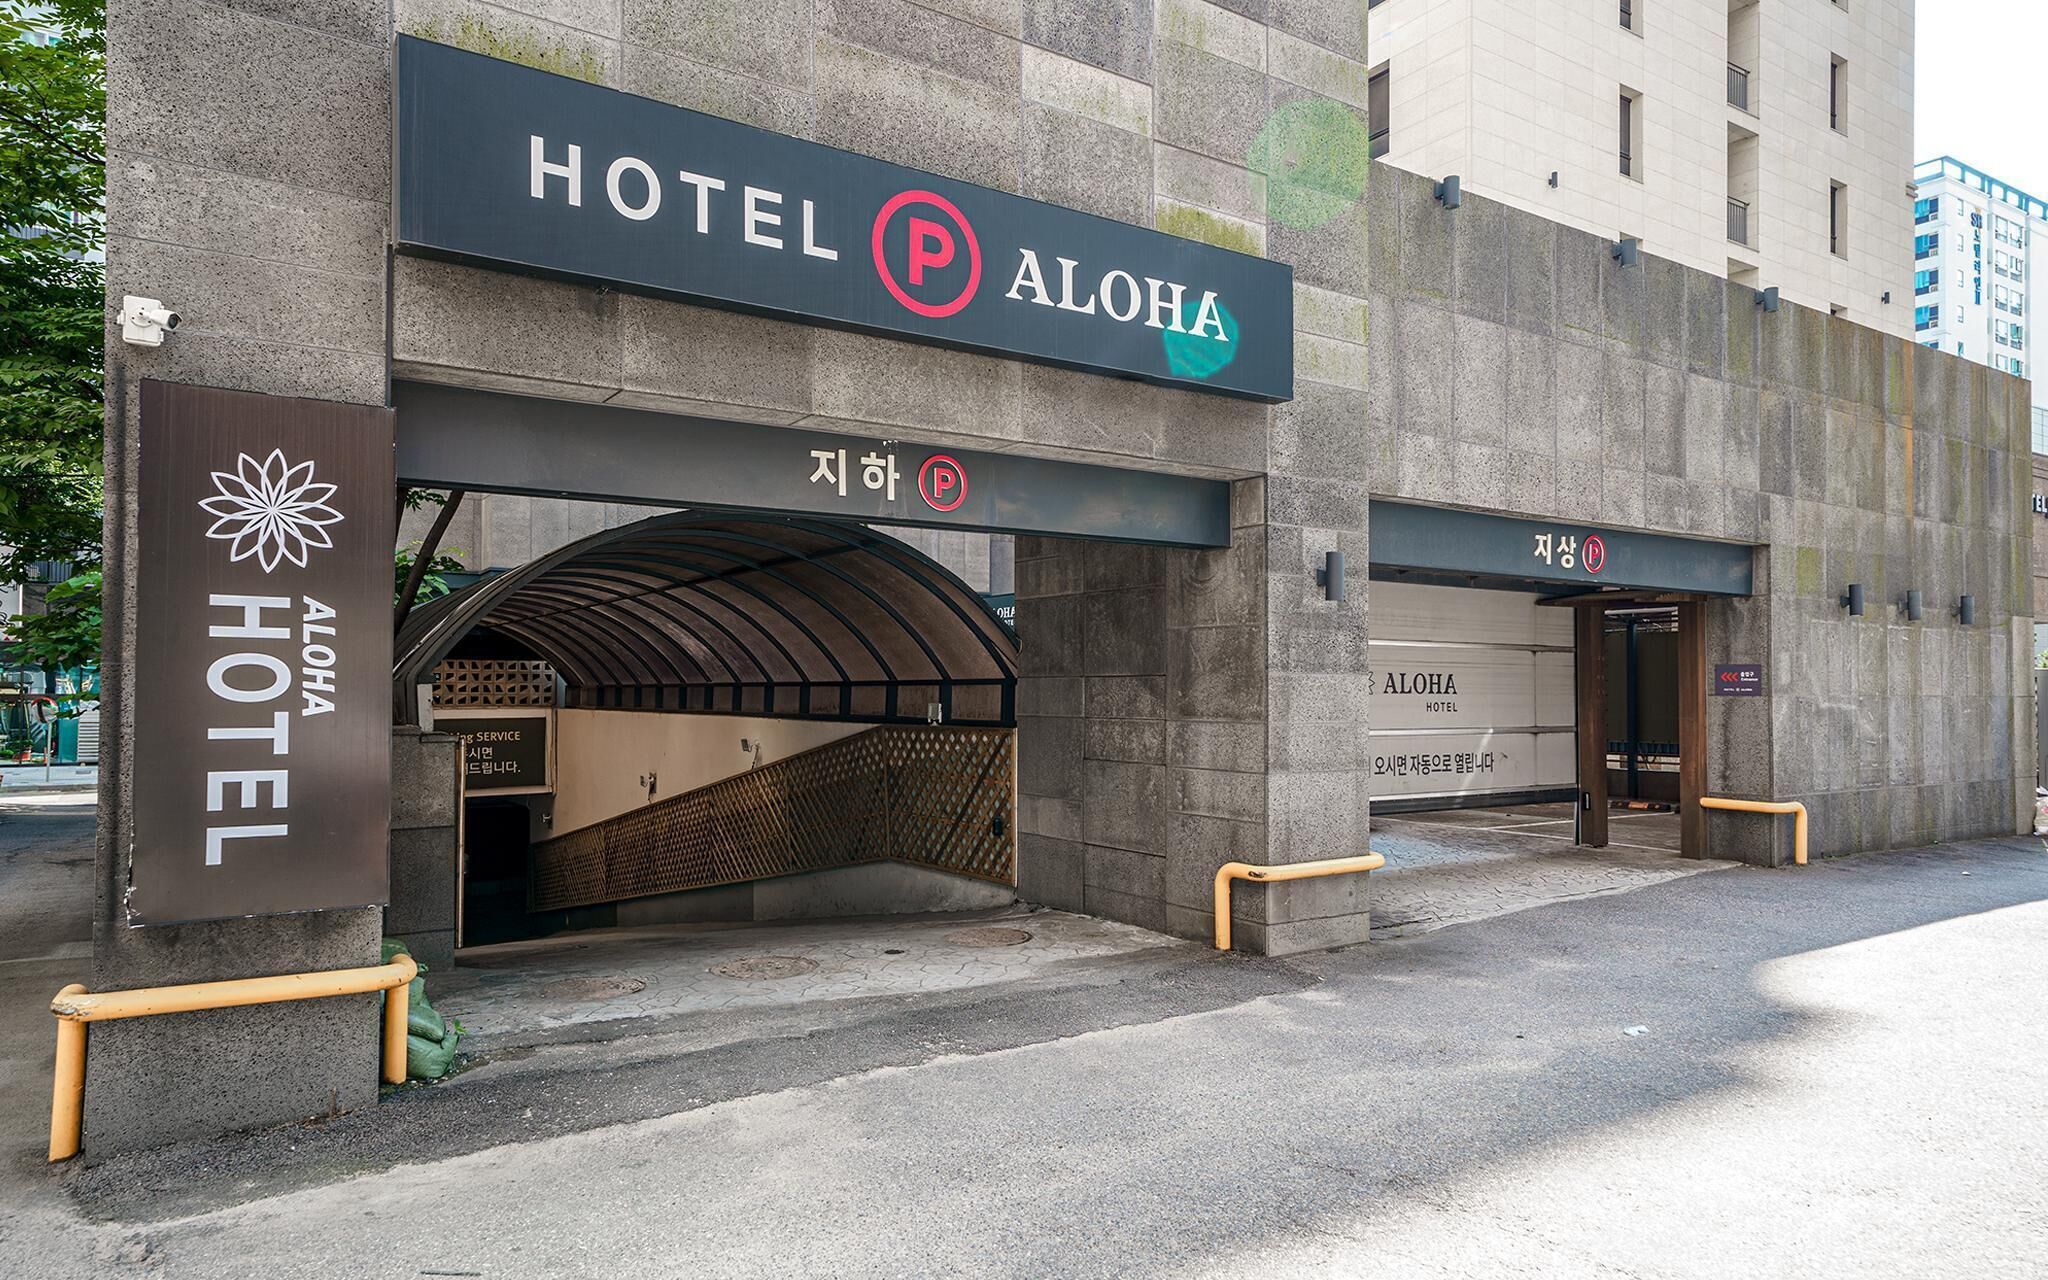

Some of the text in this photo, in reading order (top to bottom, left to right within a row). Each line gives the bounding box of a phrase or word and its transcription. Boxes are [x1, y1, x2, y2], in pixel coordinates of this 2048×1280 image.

[530, 134, 838, 262] HOTEL
[1005, 247, 1230, 342] ALOHA
[809, 449, 900, 501] 지하
[1534, 533, 1577, 568] 지상
[301, 594, 337, 717] ALOHA
[1383, 672, 1458, 695] ALOHA
[1426, 702, 1458, 712] HOTEL
[205, 593, 292, 866] HOTEL
[476, 731, 521, 742] SERVICE
[466, 747, 493, 759] 시면
[1374, 754, 1407, 776] 오시면
[1410, 754, 1452, 776] 자동으로
[1454, 752, 1494, 774] 열립니다
[465, 761, 521, 775] 드립니다.
